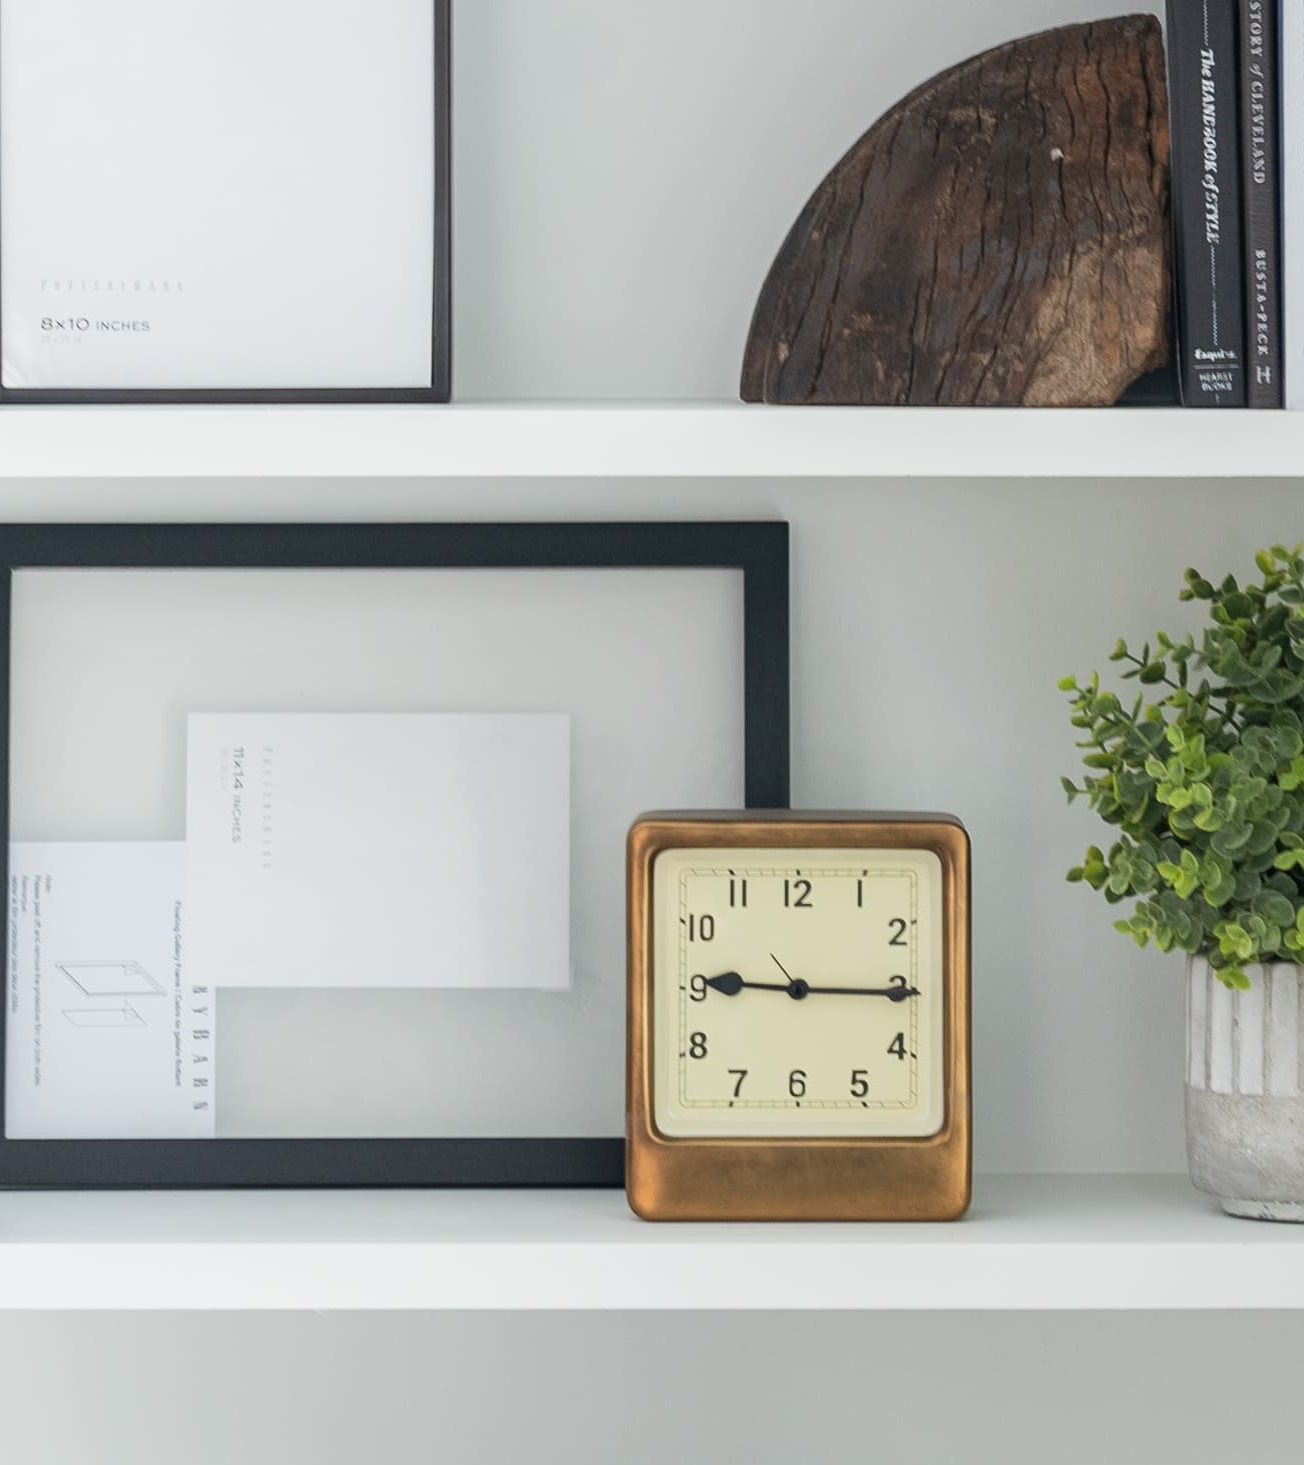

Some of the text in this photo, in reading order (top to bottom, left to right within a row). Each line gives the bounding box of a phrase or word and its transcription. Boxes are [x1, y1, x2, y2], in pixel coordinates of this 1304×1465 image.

[1200, 48, 1215, 78] The
[1249, 63, 1264, 79] of
[1201, 79, 1217, 173] HANDBOOK
[1251, 80, 1265, 184] CLEVELAND
[1202, 174, 1219, 193] of
[1255, 249, 1269, 356] BUSTA-PECK
[96, 320, 151, 332] INCHES
[729, 878, 748, 908] 11
[783, 878, 813, 908] 12
[856, 879, 864, 908] 1
[688, 914, 715, 942] 10
[888, 918, 907, 946] 2
[690, 974, 709, 1002] 9
[688, 1032, 708, 1060] 8
[887, 1032, 907, 1060] 4
[728, 1070, 748, 1098] 7
[788, 1070, 806, 1098] 6
[850, 1070, 869, 1098] 5
